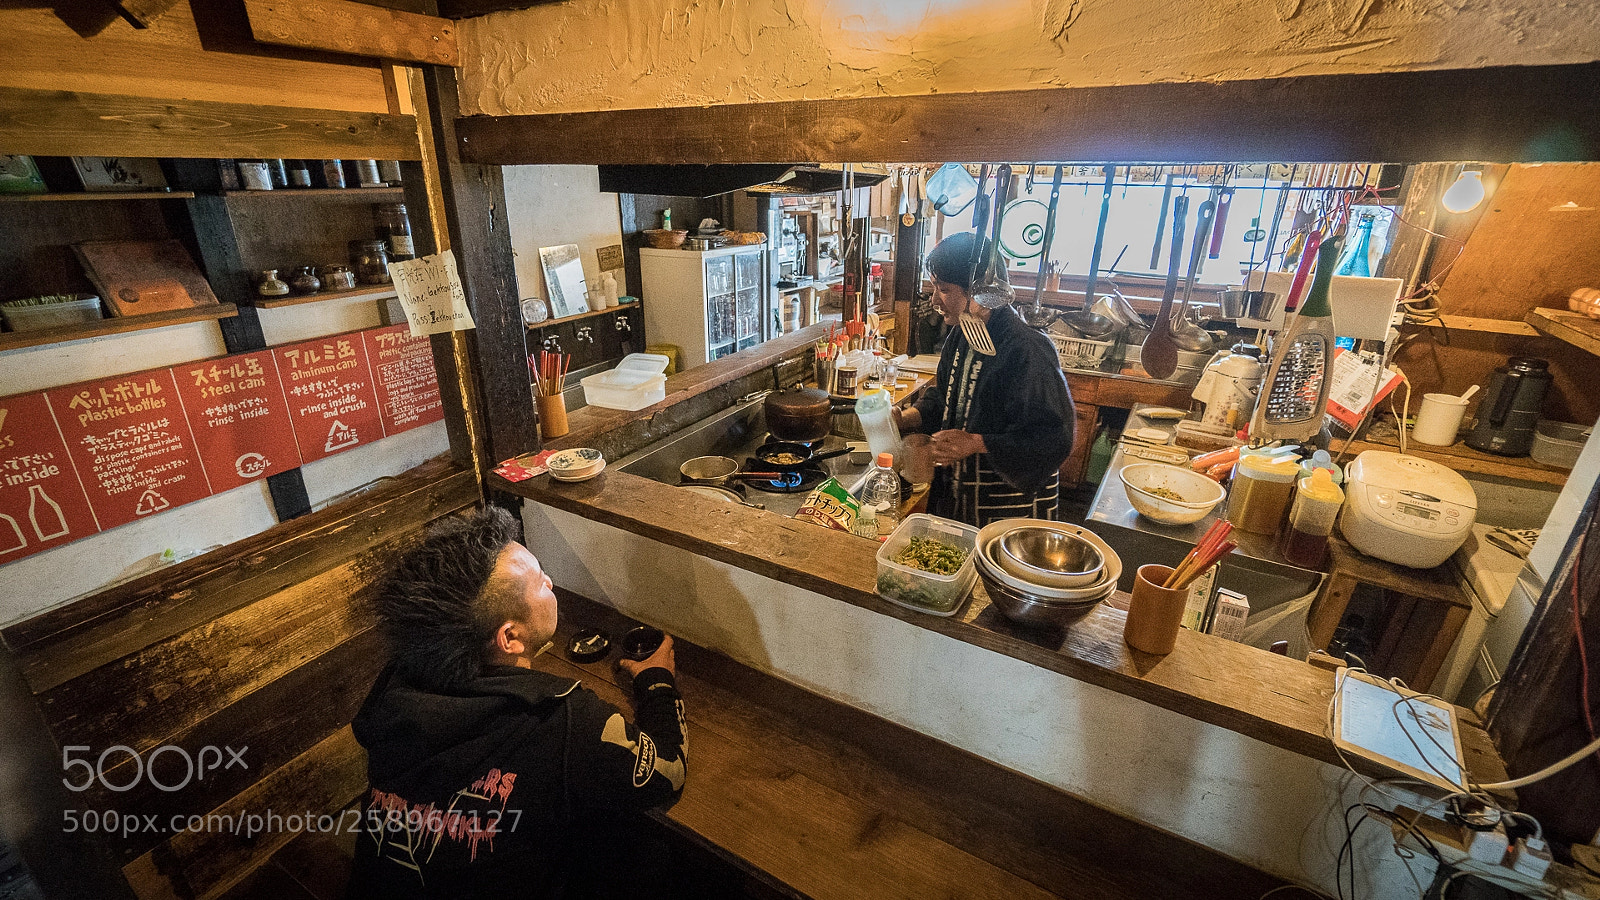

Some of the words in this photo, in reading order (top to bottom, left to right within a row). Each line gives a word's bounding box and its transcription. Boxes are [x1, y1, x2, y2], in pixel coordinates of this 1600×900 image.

[284, 340, 356, 368] アルミ缶
[190, 357, 264, 386] スチール缶
[290, 364, 336, 381] alminum
[336, 358, 358, 371] cans
[69, 379, 162, 409] ペットボトル
[200, 382, 236, 399] steel
[238, 377, 266, 390] cans
[125, 398, 167, 414] bottles
[300, 402, 327, 417] rinse
[328, 394, 357, 409] inside
[323, 407, 339, 419] and
[340, 399, 367, 414] crush
[208, 415, 235, 428] rinse
[239, 407, 270, 420] inside
[336, 428, 358, 441] アルミ
[94, 450, 129, 465] dispose
[130, 446, 147, 455] caps
[170, 442, 183, 451] and
[5, 464, 60, 486] inside
[148, 479, 162, 490] and
[106, 483, 133, 496] rinse
[134, 476, 156, 488] inside
[146, 495, 155, 507] 1
